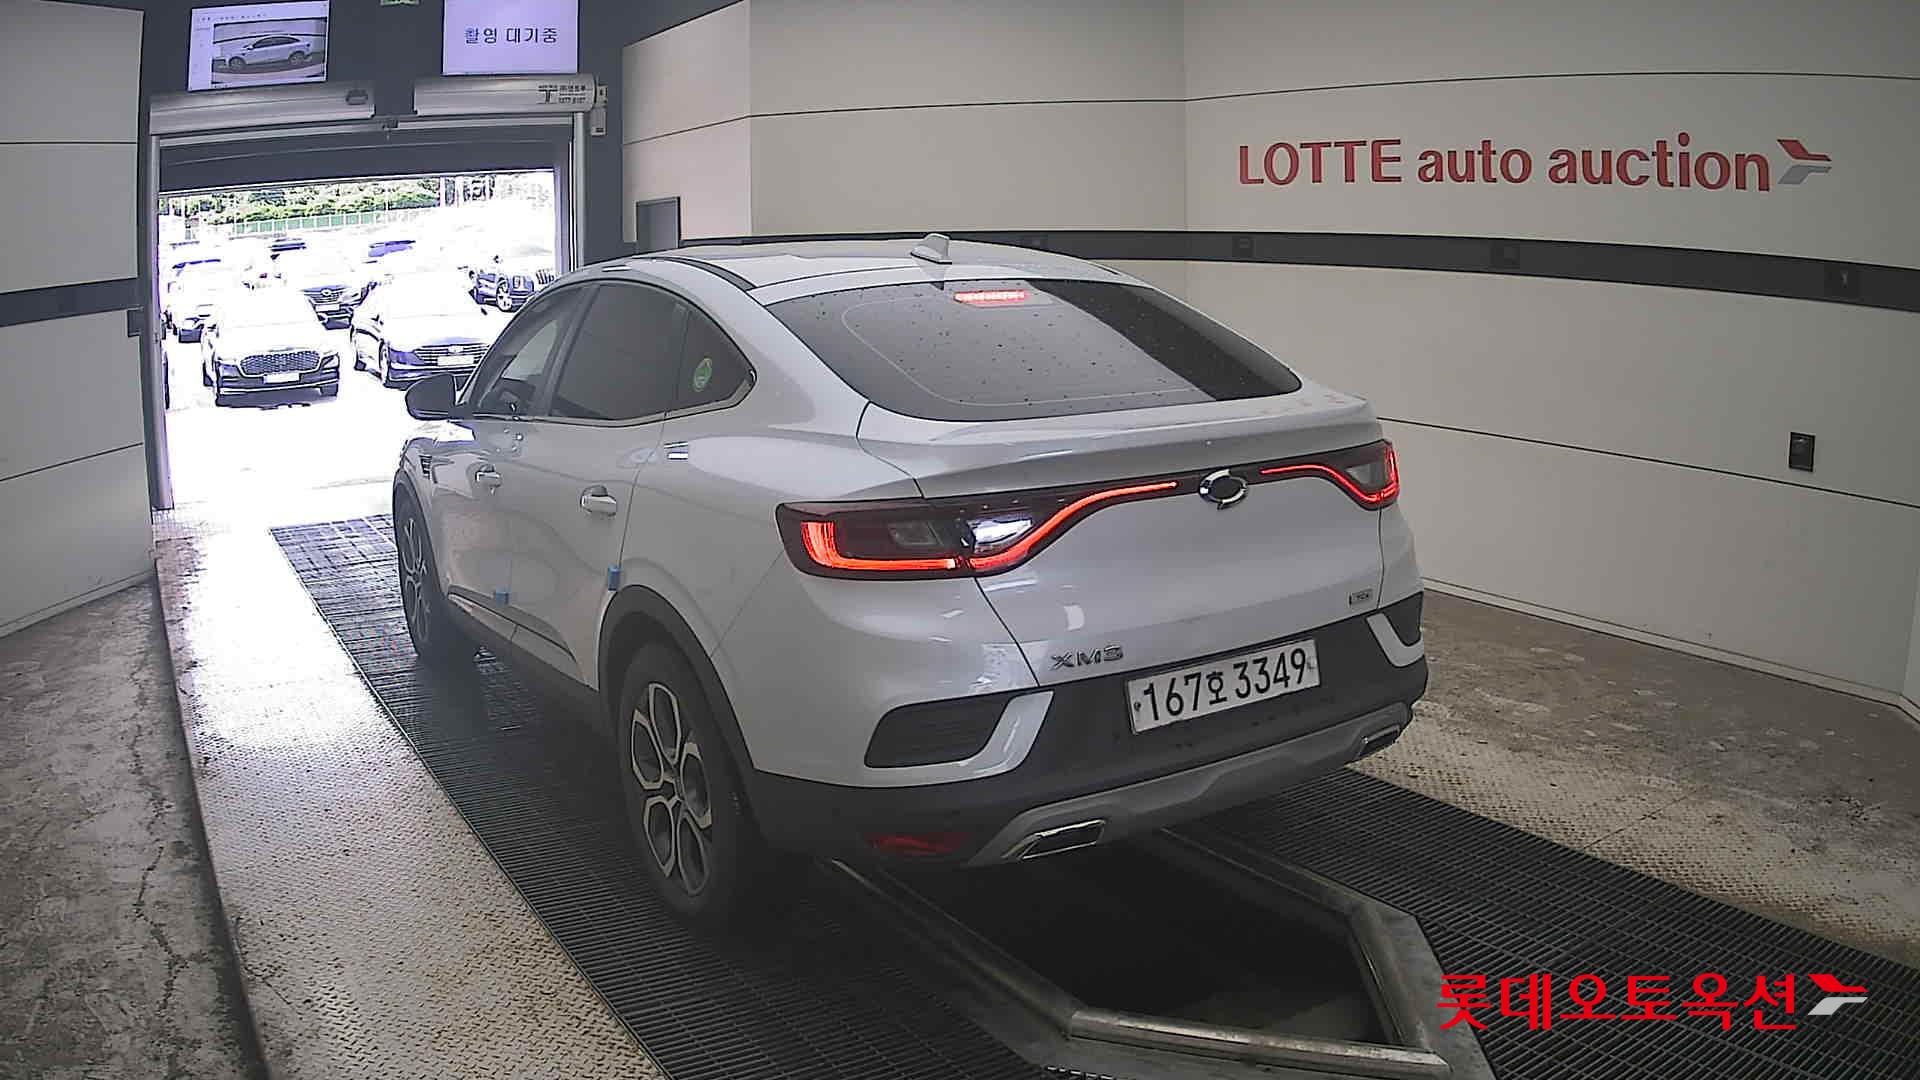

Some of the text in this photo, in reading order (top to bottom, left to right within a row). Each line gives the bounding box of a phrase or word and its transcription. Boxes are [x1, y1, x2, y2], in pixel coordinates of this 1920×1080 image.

[506, 27, 558, 43] 대기중
[1239, 132, 1770, 192] LOTTE auto auction
[1143, 648, 1307, 721] 167호 3349
